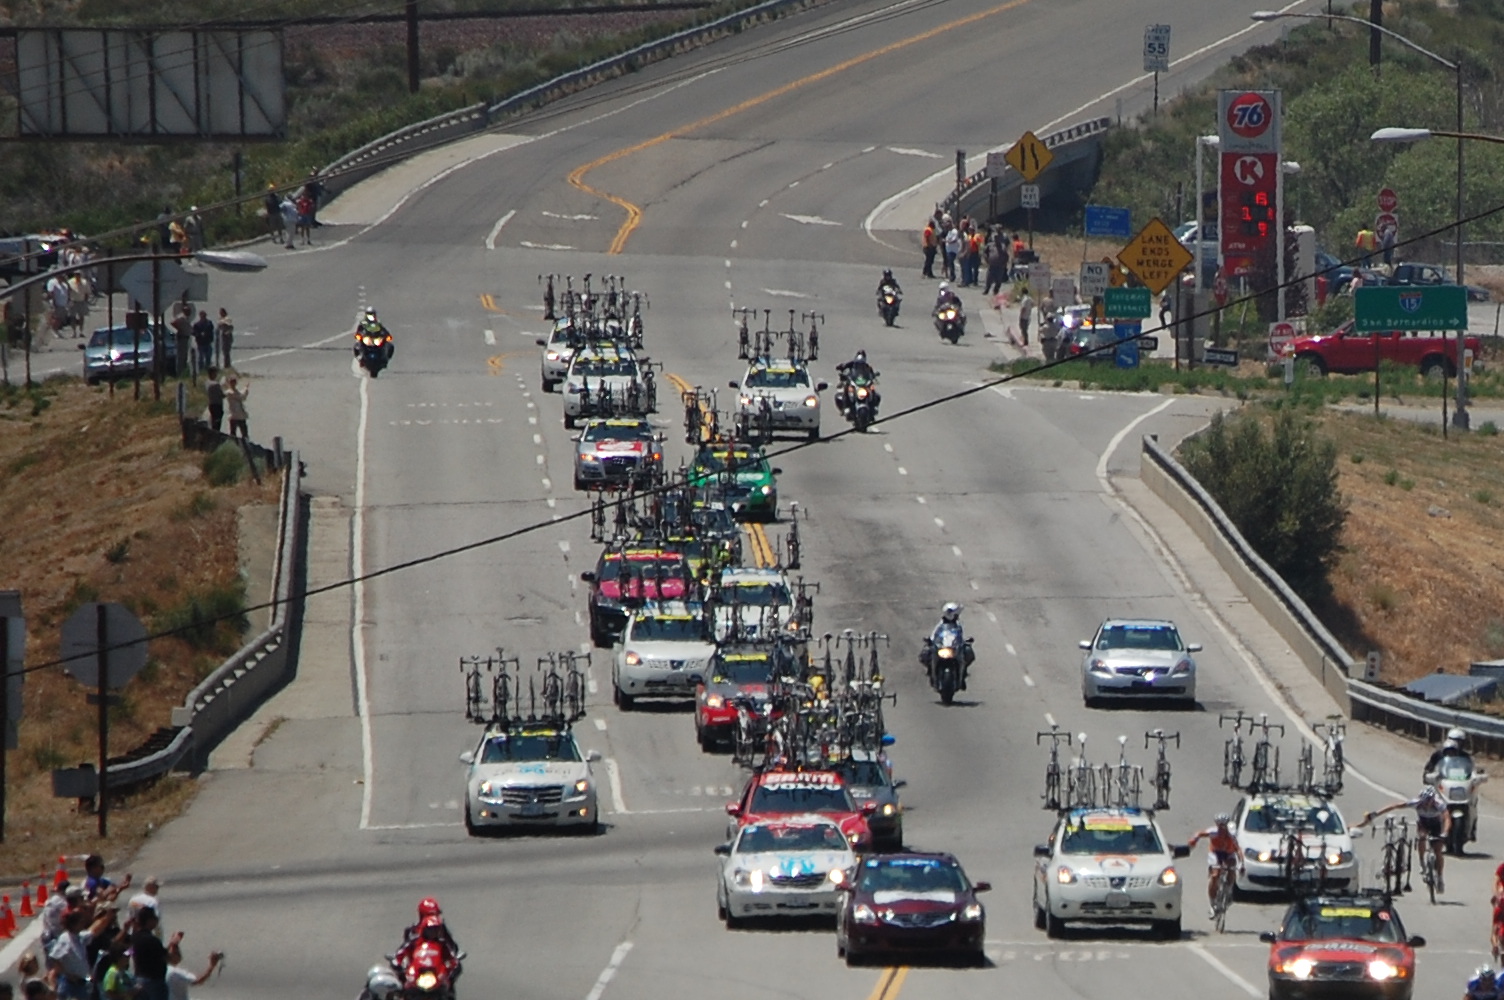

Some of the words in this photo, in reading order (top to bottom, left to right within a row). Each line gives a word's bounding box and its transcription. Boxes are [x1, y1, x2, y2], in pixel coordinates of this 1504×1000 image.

[1147, 42, 1166, 54] 55
[1233, 102, 1264, 128] 76
[1141, 235, 1169, 245] LANE
[1142, 247, 1169, 256] ENDS
[1136, 259, 1174, 267] MERGE
[1087, 266, 1103, 274] NO
[1143, 271, 1168, 279] LEFT
[1405, 299, 1417, 309] 15
[1362, 319, 1382, 327] San
[1386, 318, 1444, 327] Bernardino
